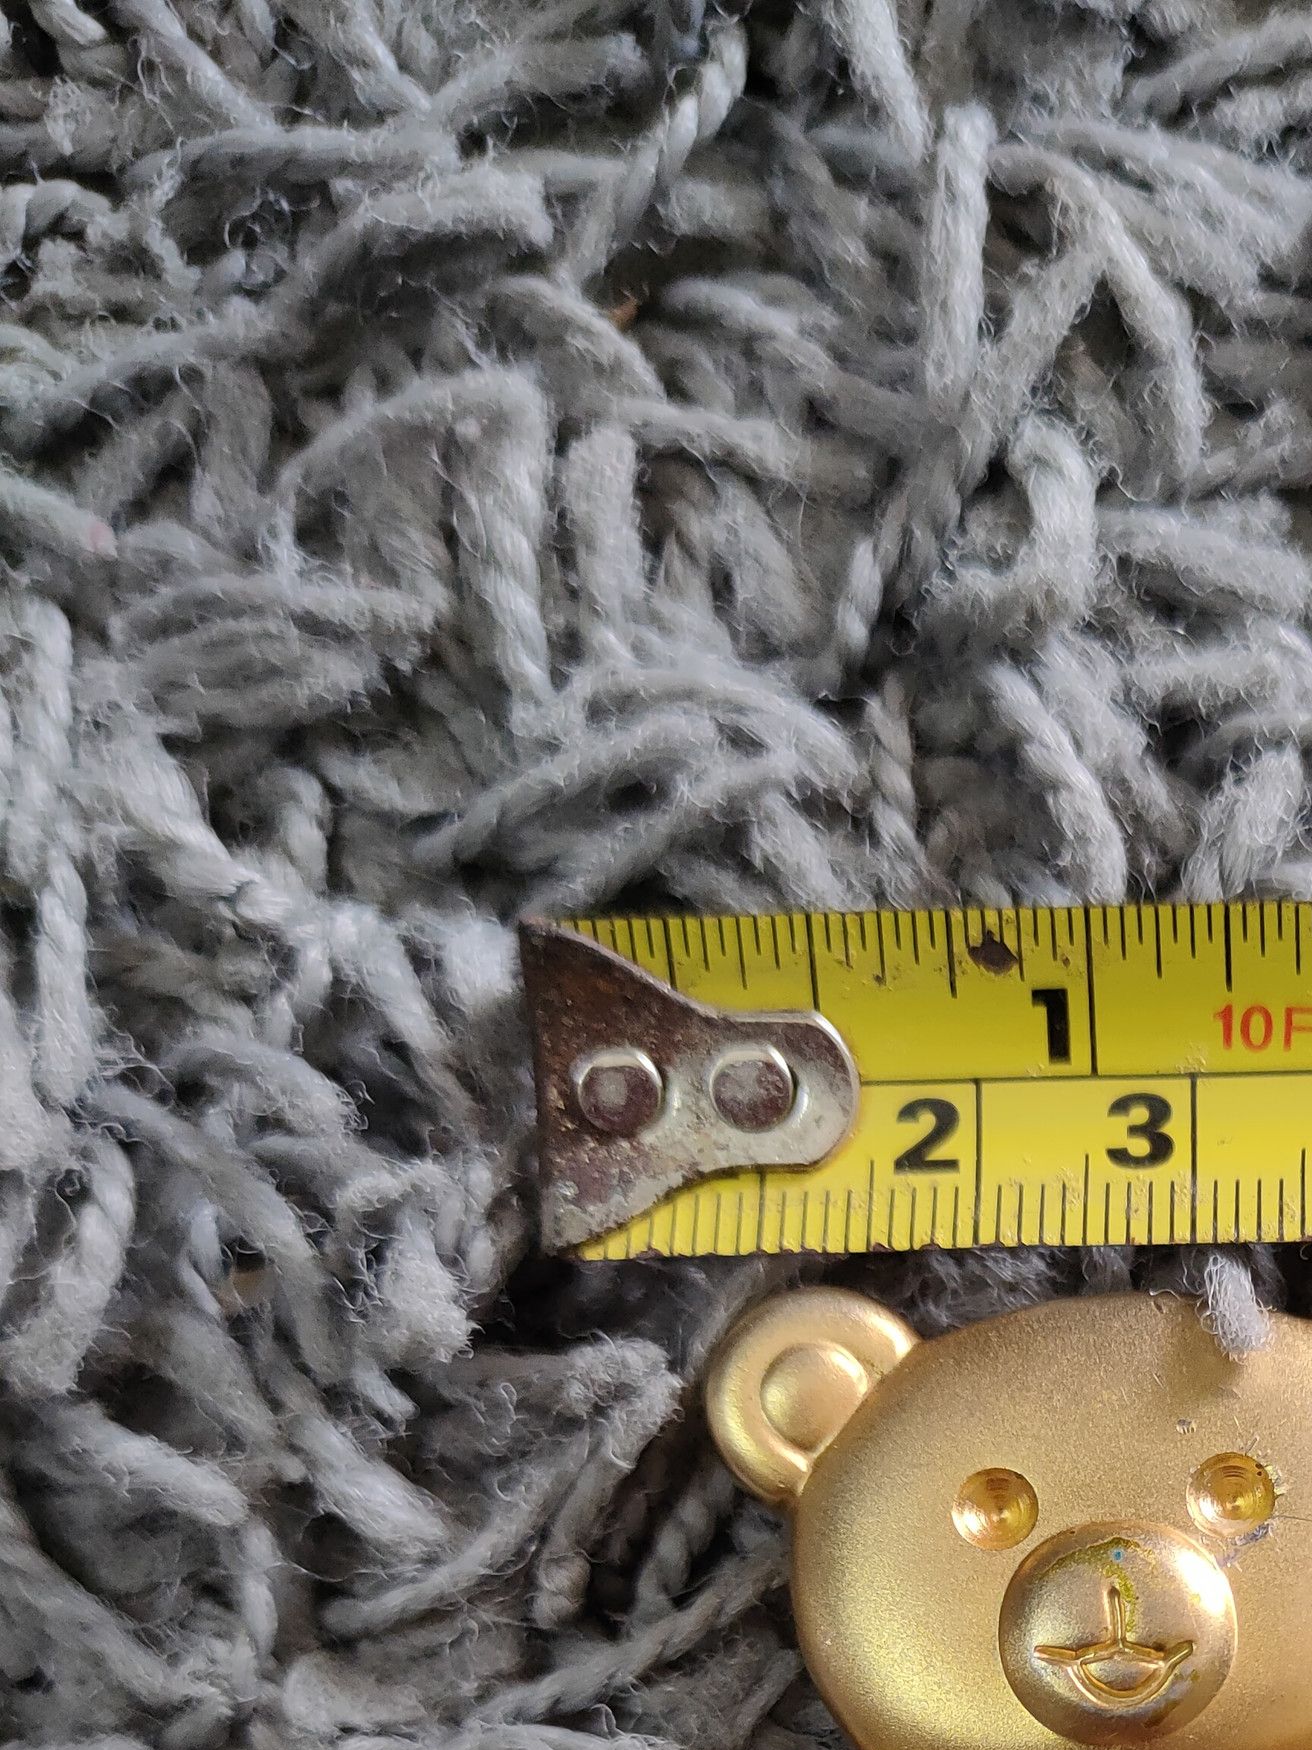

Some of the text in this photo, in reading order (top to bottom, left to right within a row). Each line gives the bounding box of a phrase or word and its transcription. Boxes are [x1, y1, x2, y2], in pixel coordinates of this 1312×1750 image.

[1029, 988, 1072, 1066] 1
[894, 1098, 962, 1174] 2
[1105, 1092, 1175, 1169] 3
